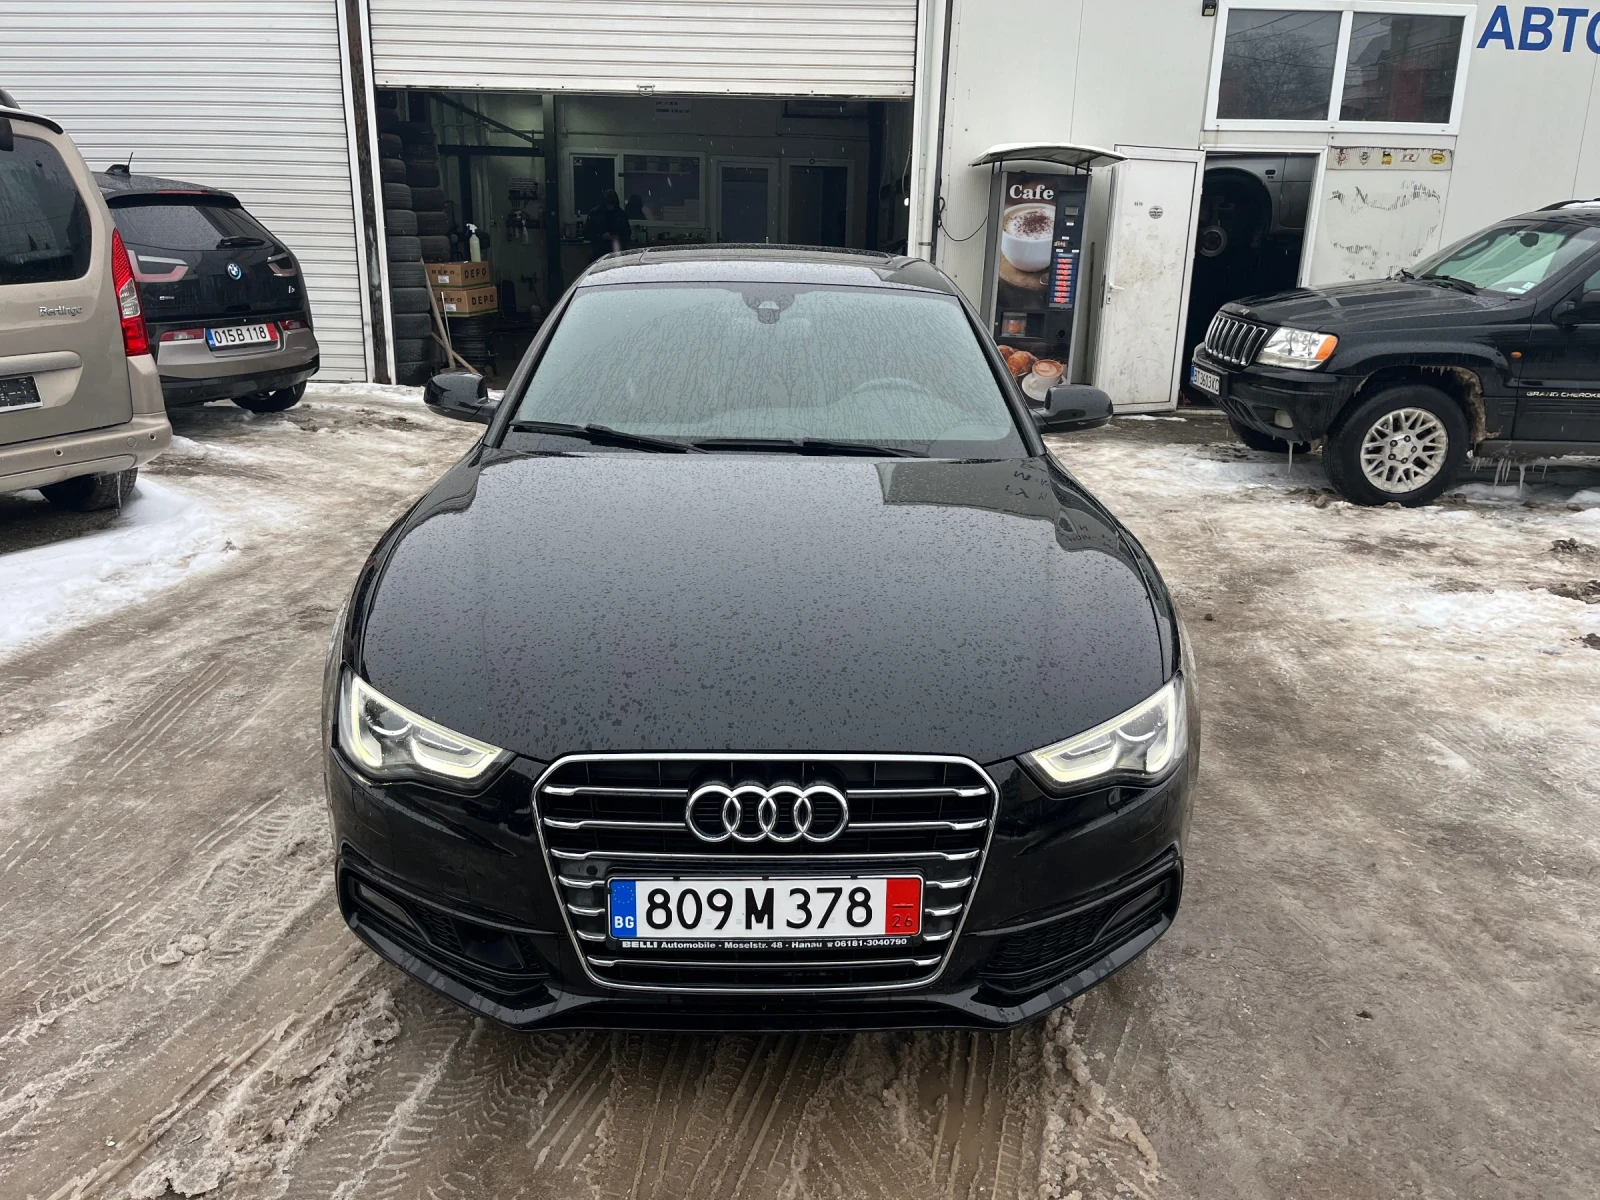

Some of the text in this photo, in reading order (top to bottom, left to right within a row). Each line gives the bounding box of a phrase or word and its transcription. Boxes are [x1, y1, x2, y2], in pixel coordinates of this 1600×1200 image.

[1009, 184, 1054, 200] Cafe
[464, 267, 487, 279] DEPO
[471, 294, 494, 306] DEPO
[38, 305, 83, 317] Berlingo
[214, 328, 236, 344] 015
[246, 326, 267, 341] 118
[645, 886, 873, 930] 809 M 378
[614, 915, 634, 929] BG
[891, 913, 914, 929] 26
[622, 941, 658, 949] BELLI
[661, 941, 716, 949] Automobile
[724, 941, 769, 949] Moselstr.
[771, 941, 783, 949] 48
[791, 941, 823, 949] Hanau
[834, 938, 908, 948] 06181-3040790
